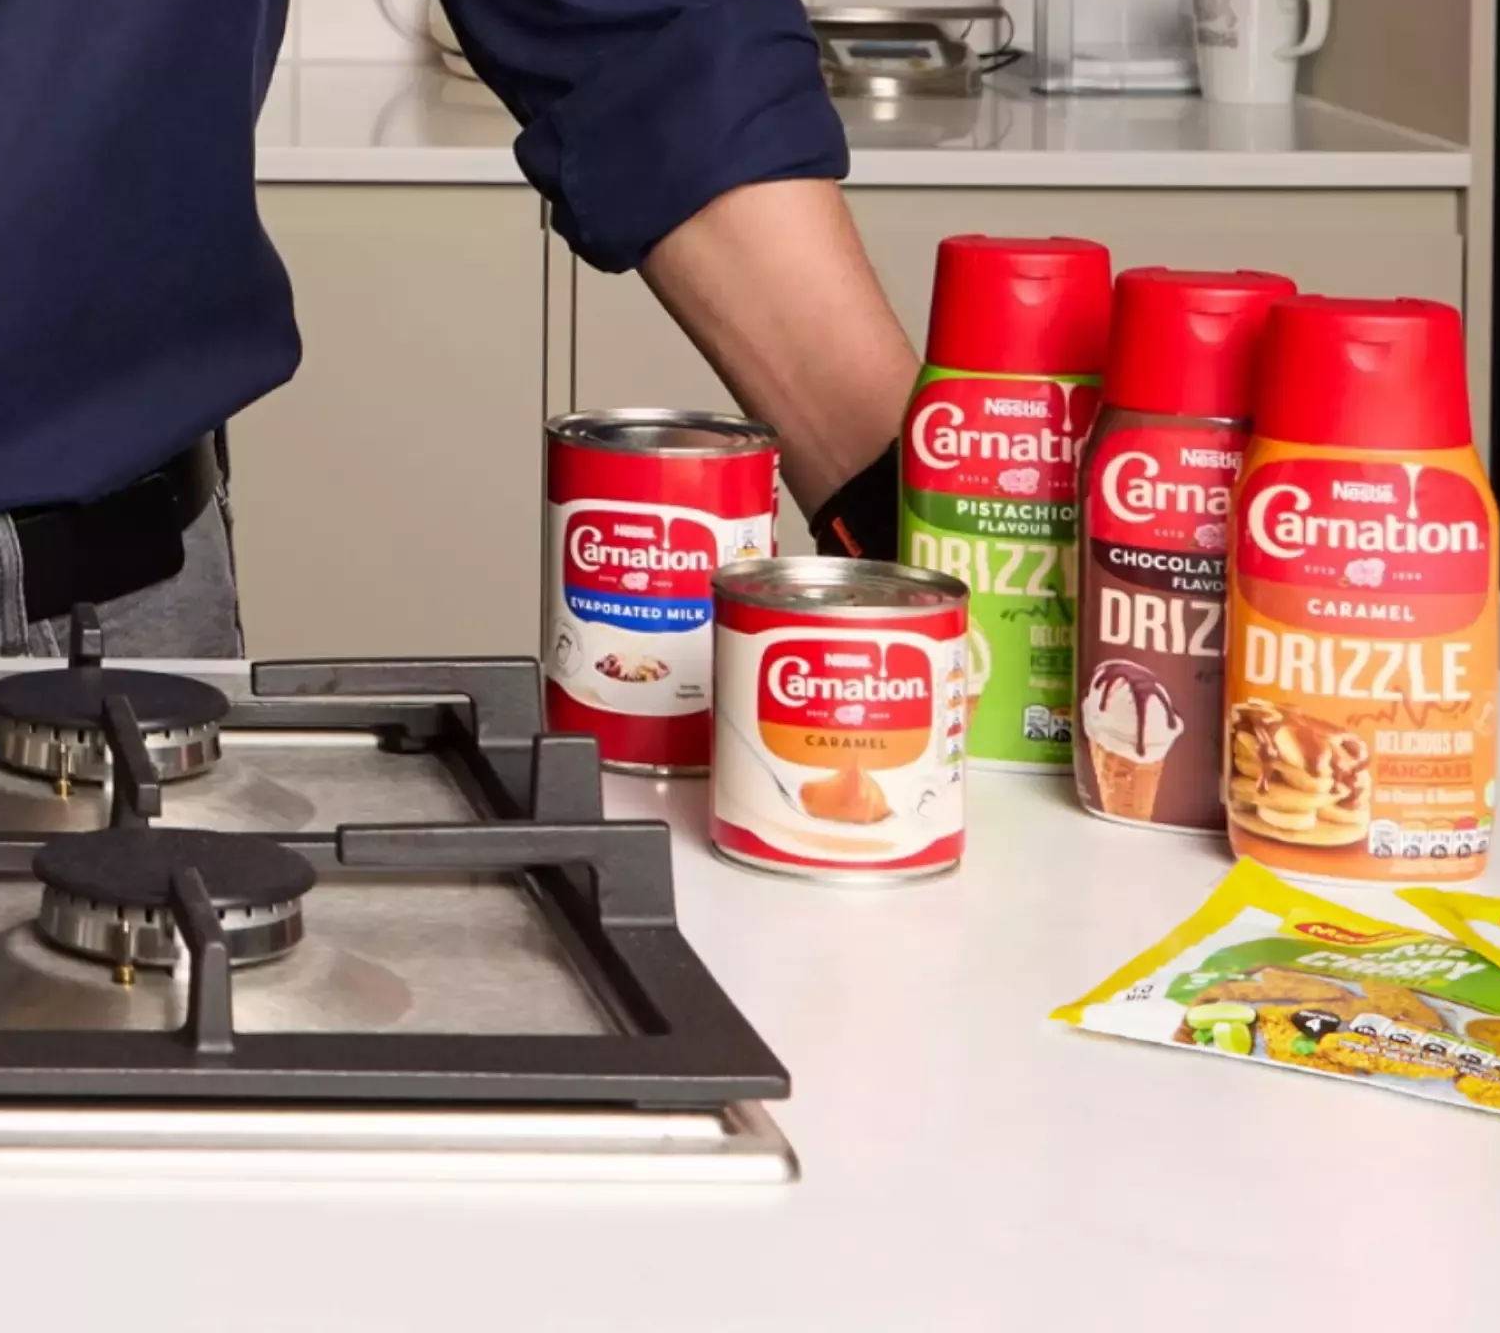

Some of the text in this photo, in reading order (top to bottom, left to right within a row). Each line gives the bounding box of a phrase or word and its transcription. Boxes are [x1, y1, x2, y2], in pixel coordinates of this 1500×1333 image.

[956, 499, 1074, 521] PISTACHIO
[1248, 484, 1480, 559] Carnation
[978, 520, 1052, 536] FLAVOUR
[569, 524, 709, 573] Carnation
[1109, 548, 1226, 575] CHOCOLAT
[1172, 576, 1226, 593] FLAVO
[570, 596, 705, 621] EVAPORATED MILK
[1307, 598, 1416, 623] CARAMEL
[1244, 624, 1472, 703] DRIZZLE
[767, 655, 925, 708] Carnation
[804, 734, 888, 749] CARAMEL
